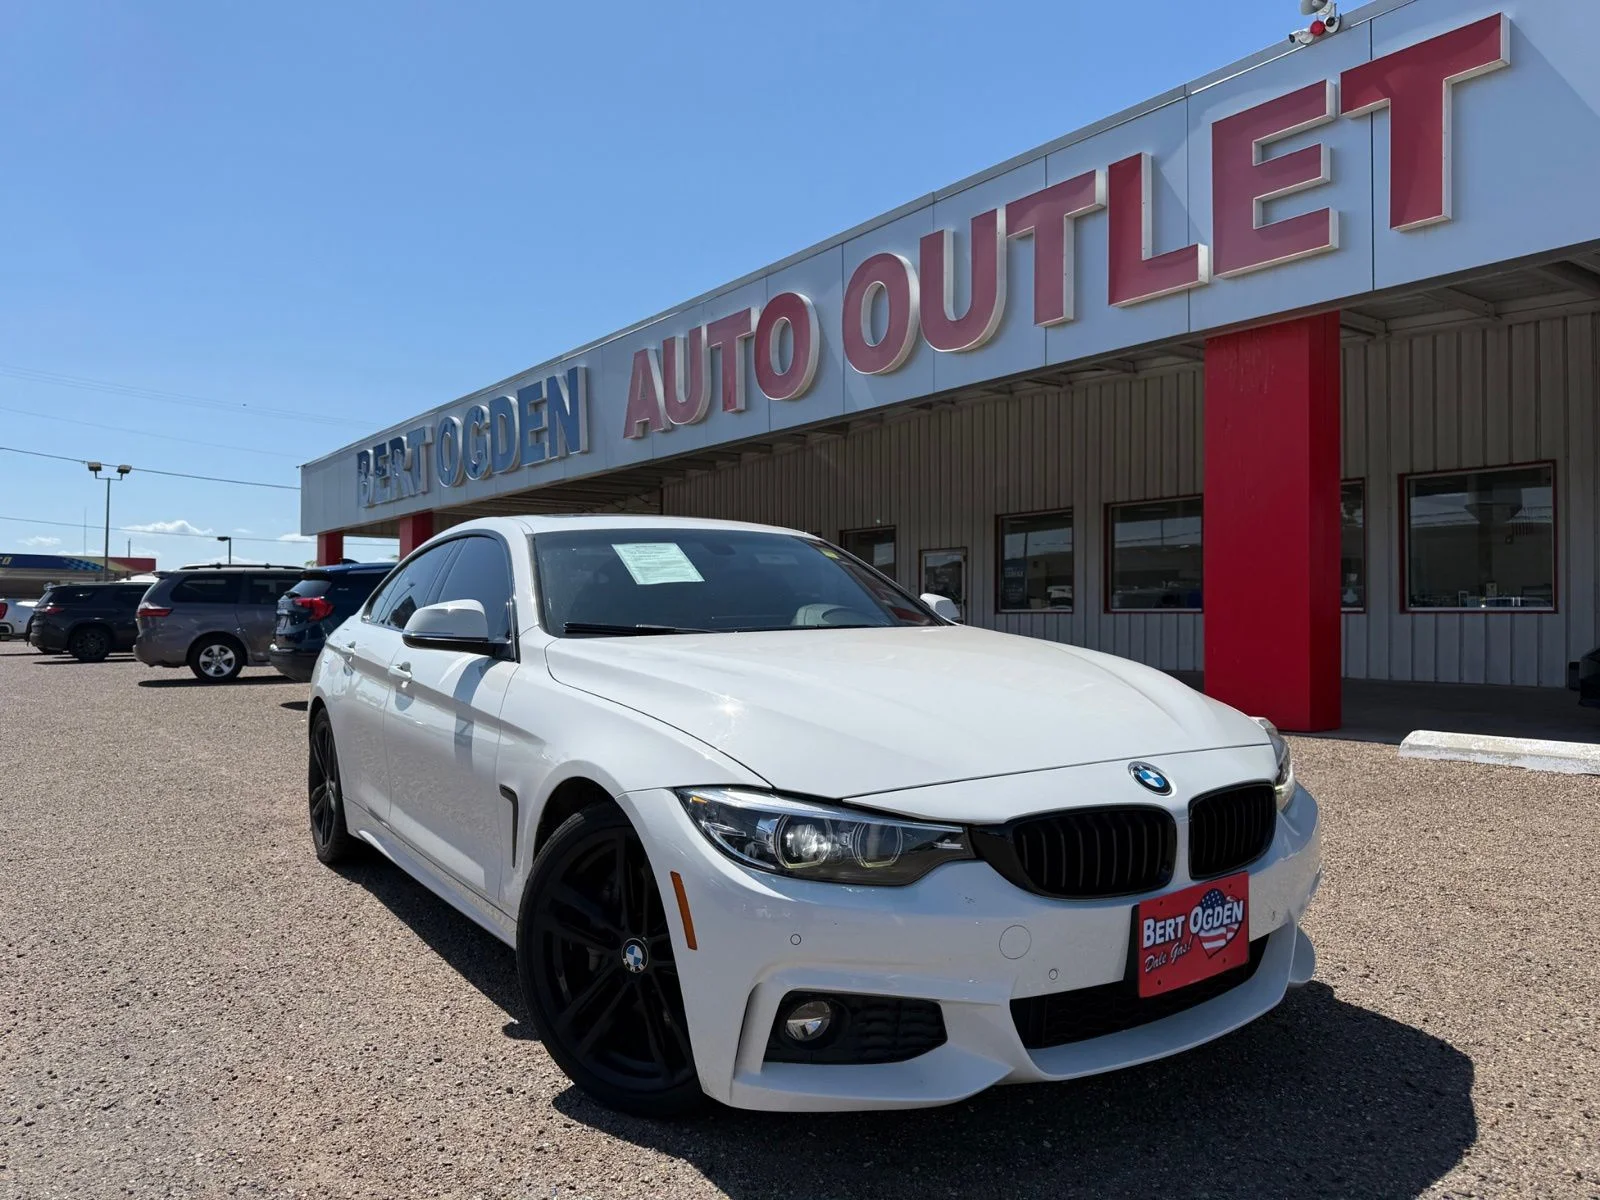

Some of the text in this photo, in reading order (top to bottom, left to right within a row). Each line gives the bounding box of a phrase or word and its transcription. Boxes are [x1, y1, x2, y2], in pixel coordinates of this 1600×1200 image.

[356, 12, 1511, 508] BERT OGDEN AUTO OUTLET
[1143, 900, 1244, 949] BERT OGDEN
